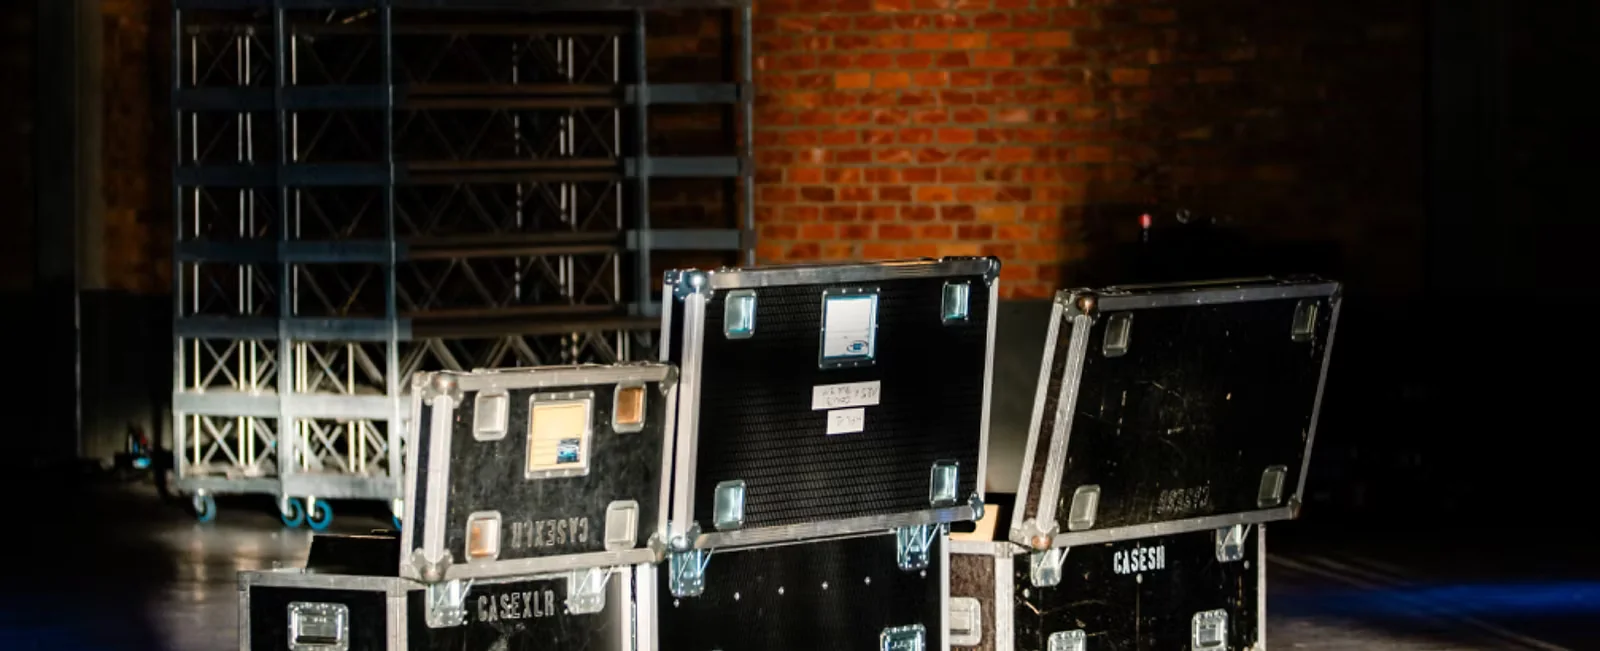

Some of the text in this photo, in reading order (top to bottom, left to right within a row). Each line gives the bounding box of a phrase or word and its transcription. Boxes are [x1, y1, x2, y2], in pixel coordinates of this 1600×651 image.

[512, 517, 588, 548] CASEXLR
[1114, 545, 1166, 575] CASESH
[477, 590, 555, 622] CASEXLR
